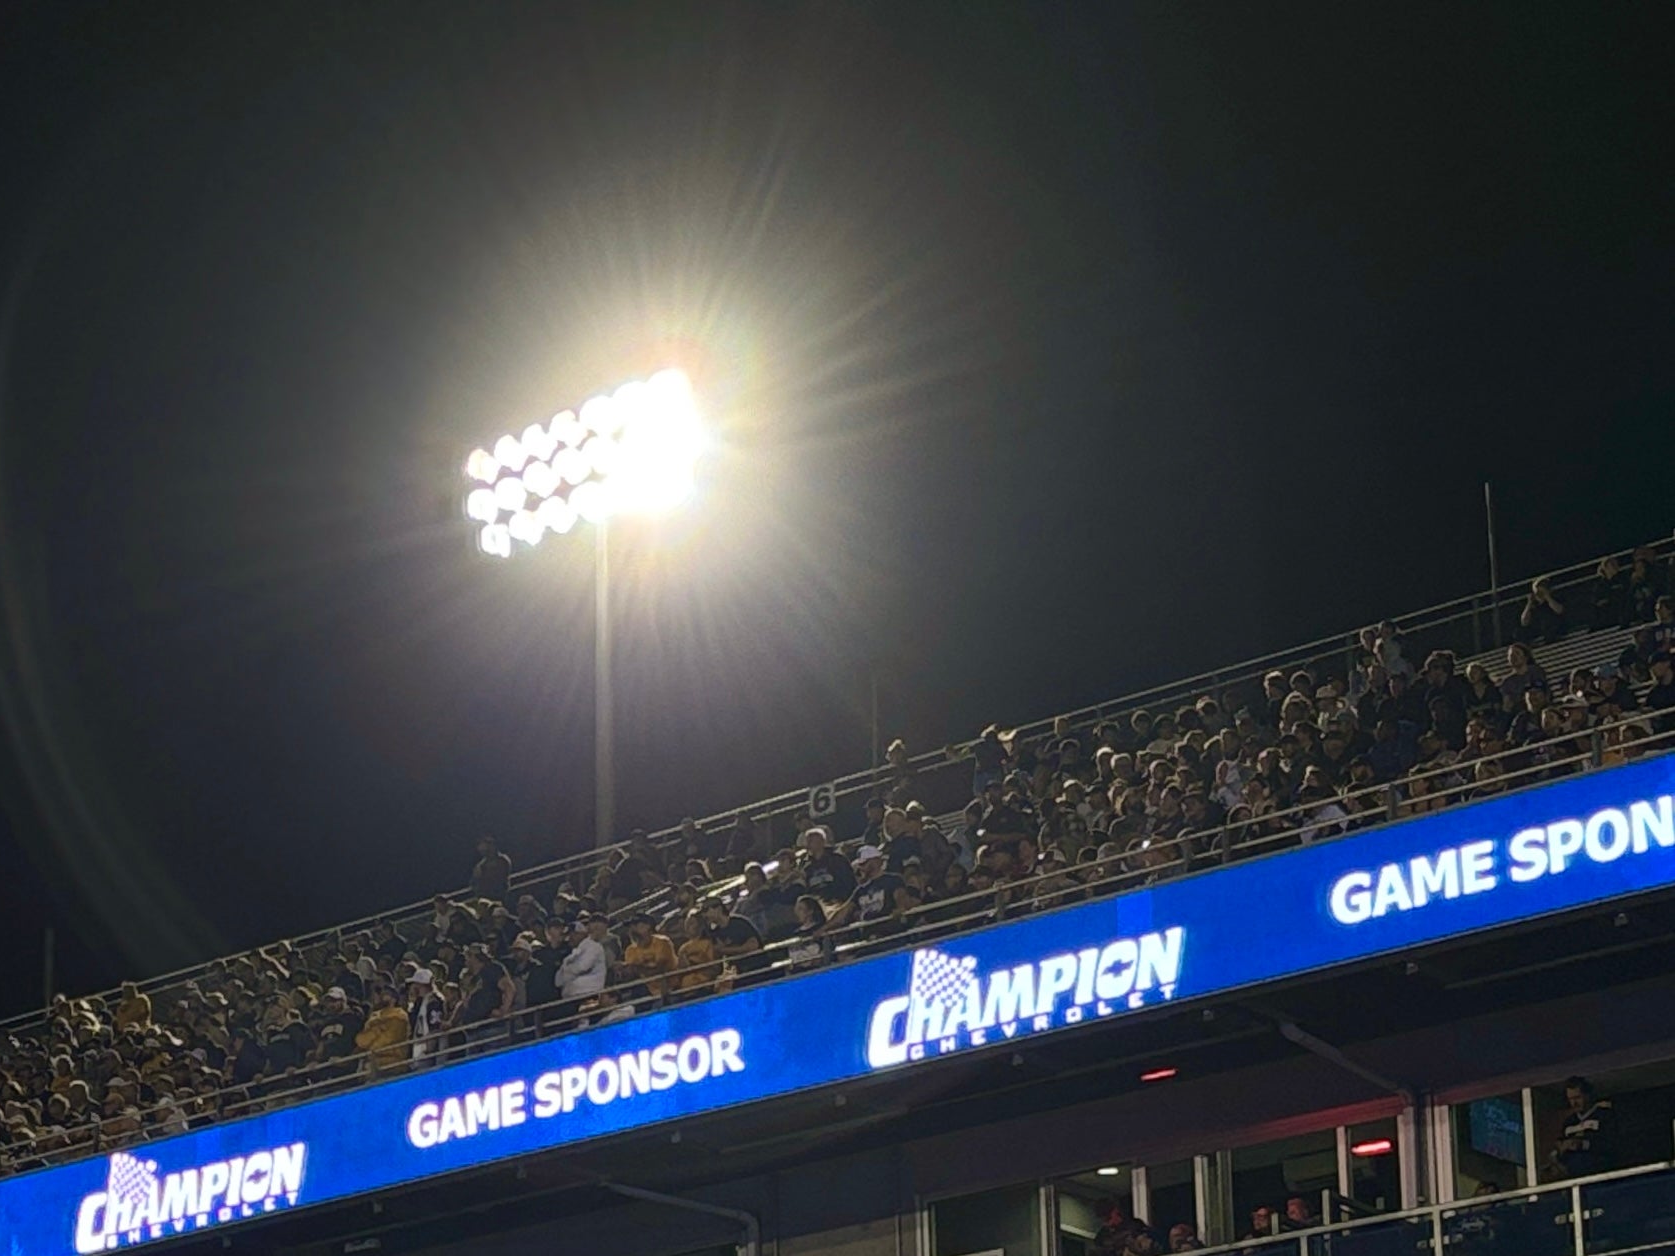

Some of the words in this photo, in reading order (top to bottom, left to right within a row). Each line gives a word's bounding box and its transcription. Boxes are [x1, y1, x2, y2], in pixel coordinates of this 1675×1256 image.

[813, 786, 831, 814] 6
[1330, 840, 1497, 924] GAME
[1508, 795, 1675, 883] SPON
[868, 926, 1183, 1068] CHAMPION
[909, 985, 1175, 1062] CHEVROLET
[407, 1080, 526, 1149] GAME
[533, 1028, 745, 1118] SPONSOR
[75, 1142, 305, 1254] CHAMPION
[106, 1193, 298, 1249] CHEVROLET
